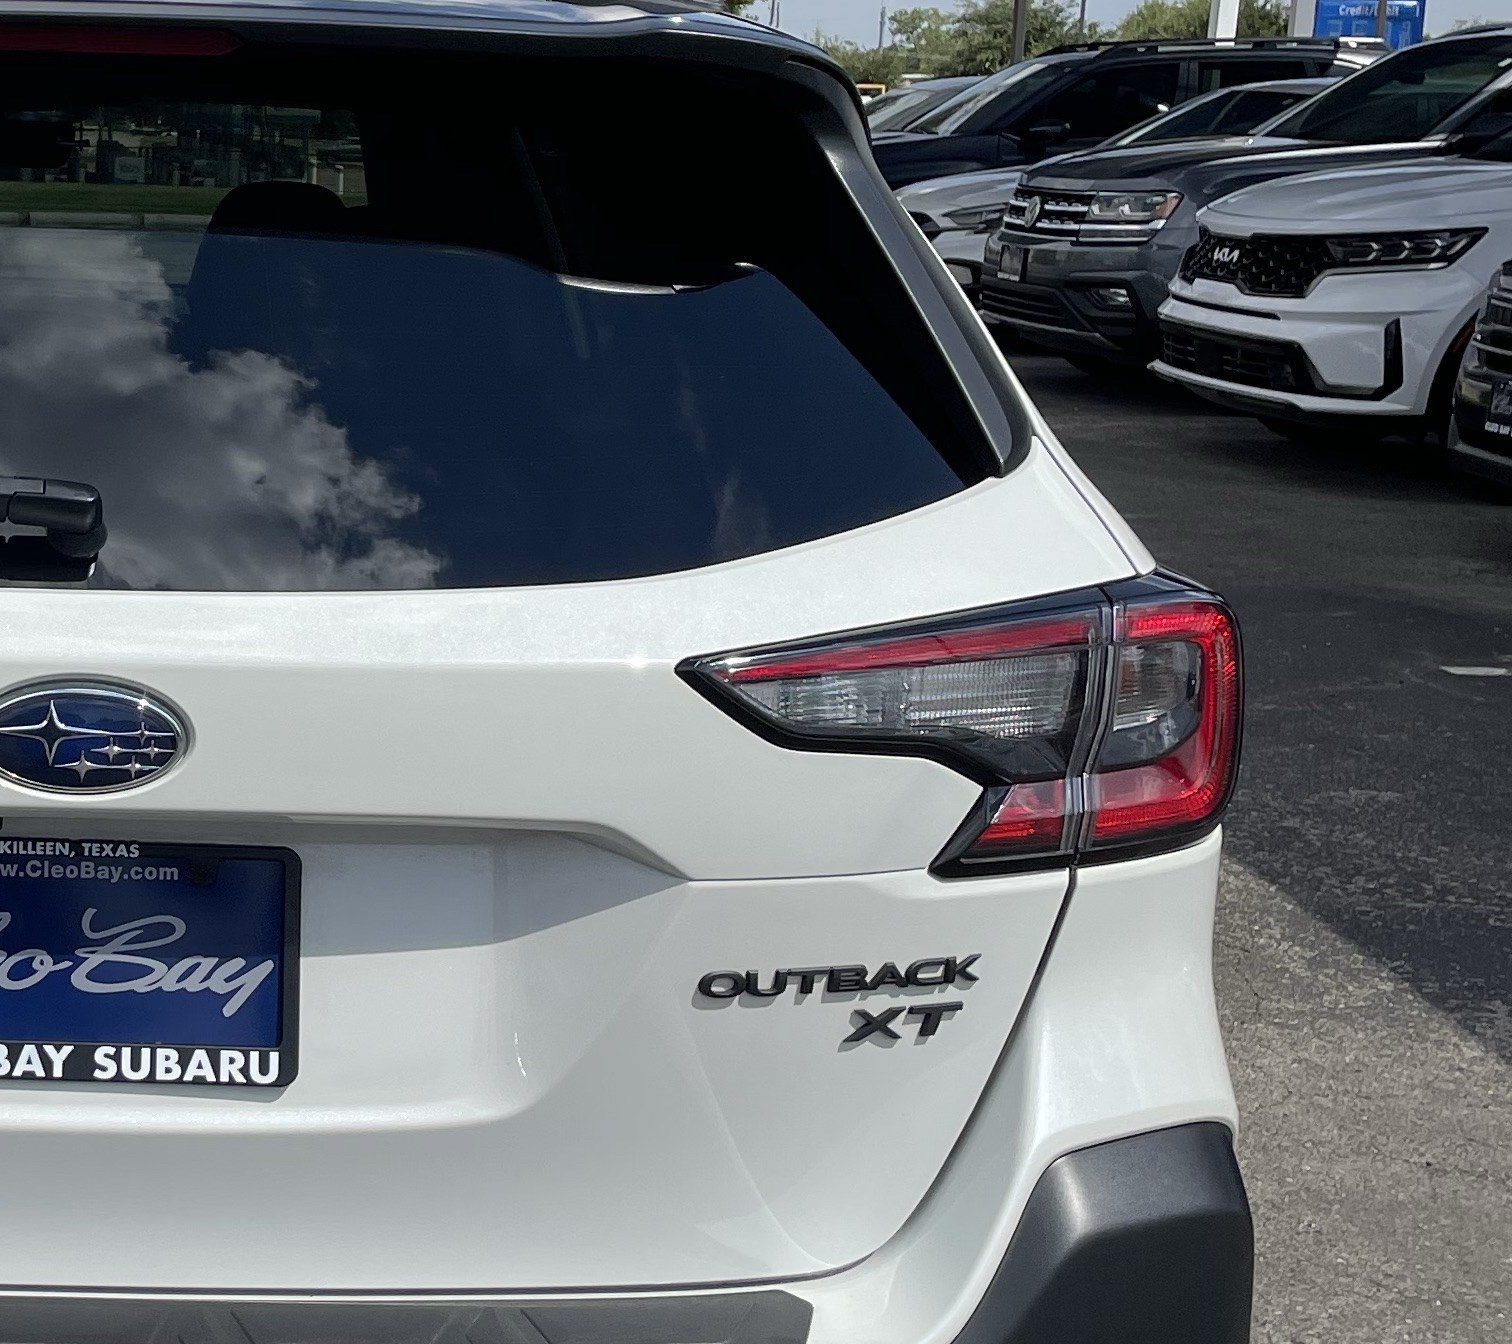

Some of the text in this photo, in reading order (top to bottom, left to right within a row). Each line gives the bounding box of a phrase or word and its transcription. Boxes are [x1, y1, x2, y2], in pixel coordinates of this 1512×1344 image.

[81, 841, 141, 859] TEXAS
[70, 906, 275, 1018] Bay
[697, 953, 982, 999] OUTBACK
[842, 1000, 965, 1044] XT
[92, 1047, 281, 1084] SUBARU
